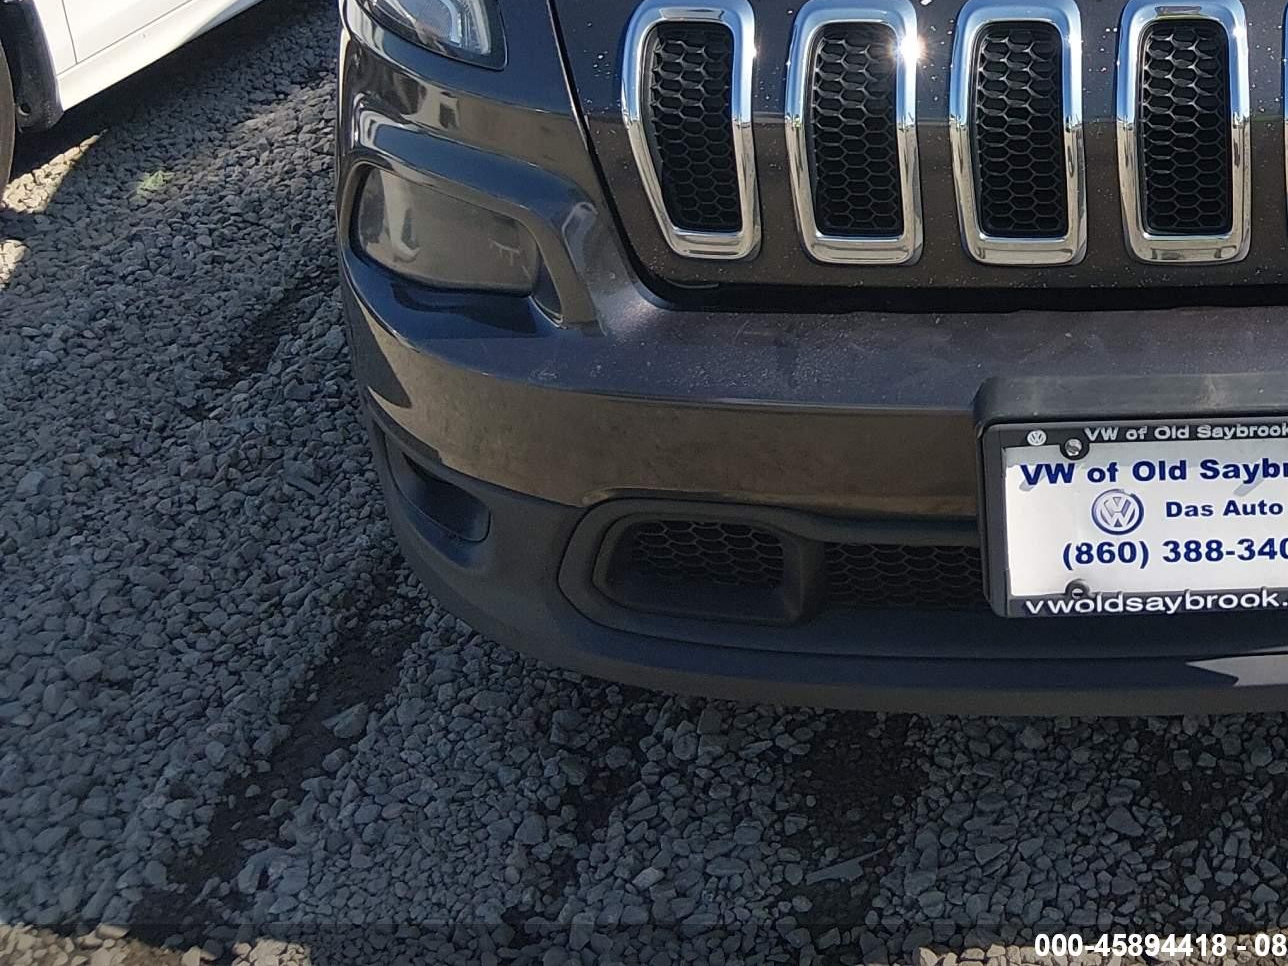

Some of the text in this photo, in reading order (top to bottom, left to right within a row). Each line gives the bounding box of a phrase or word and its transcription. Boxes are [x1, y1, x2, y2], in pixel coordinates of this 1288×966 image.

[1084, 426, 1119, 442] VW
[1126, 425, 1148, 440] of
[1154, 424, 1190, 439] Old
[1021, 463, 1076, 485] VW
[1087, 461, 1119, 483] of
[1132, 459, 1187, 482] Old
[1165, 500, 1215, 518] Das
[1222, 499, 1285, 517] Auto
[1062, 540, 1150, 570] (860)
